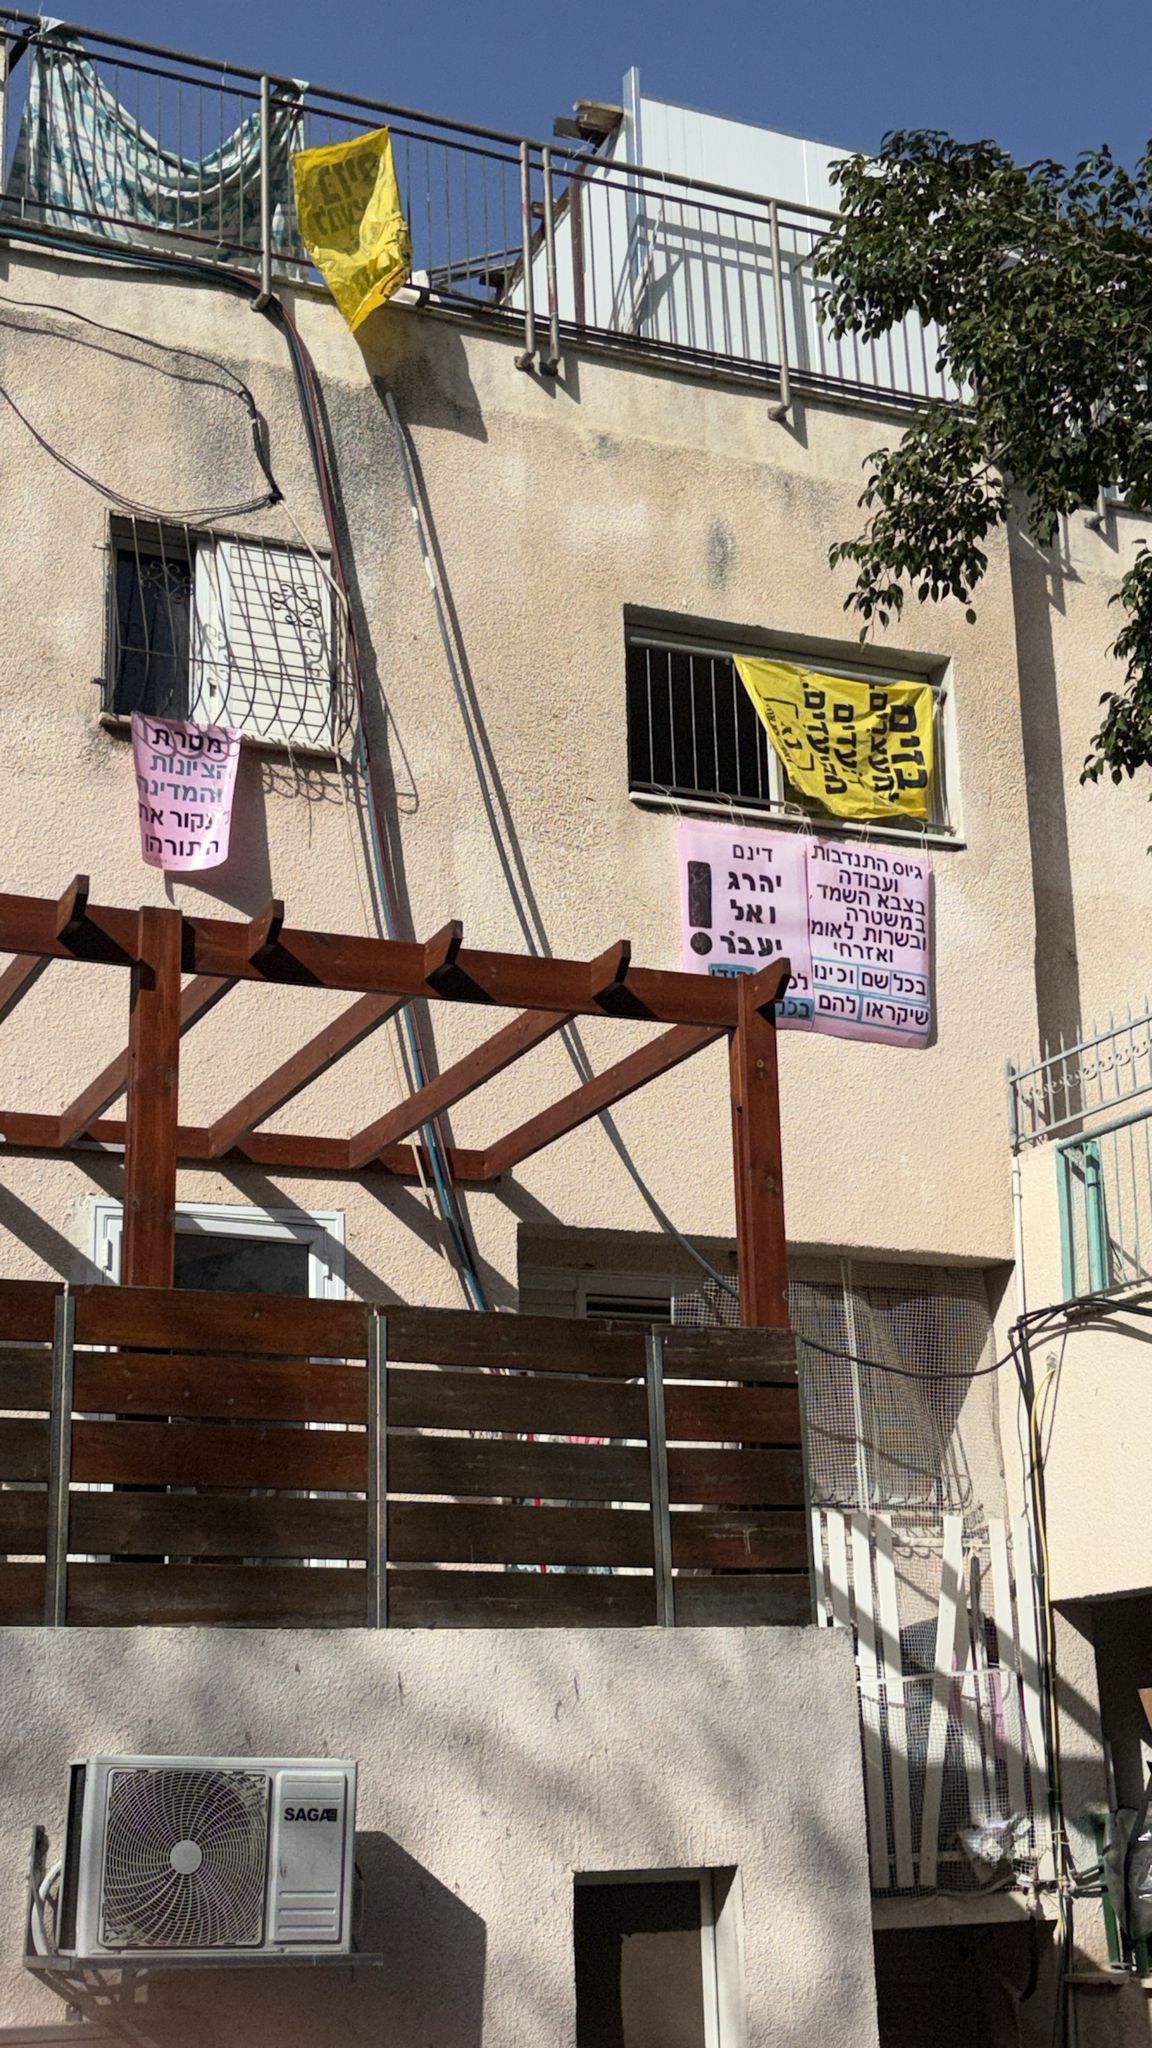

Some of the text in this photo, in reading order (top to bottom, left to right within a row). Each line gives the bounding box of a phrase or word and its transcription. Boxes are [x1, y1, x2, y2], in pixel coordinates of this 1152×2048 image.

[152, 728, 221, 754] מטרת
[150, 754, 231, 780] הציונות
[732, 844, 773, 863] דינם
[811, 845, 888, 873] התנדבות
[727, 871, 782, 893] יהרג
[839, 869, 898, 893] ועבודה
[729, 899, 776, 924] ואל
[877, 893, 926, 916] בצבא
[846, 907, 926, 933] במשטרה
[863, 927, 926, 951] ובשרות
[833, 942, 893, 963] ואזרחי
[861, 971, 889, 989] שם
[893, 973, 926, 996] בכל
[819, 994, 929, 1026] שיקראו להם
